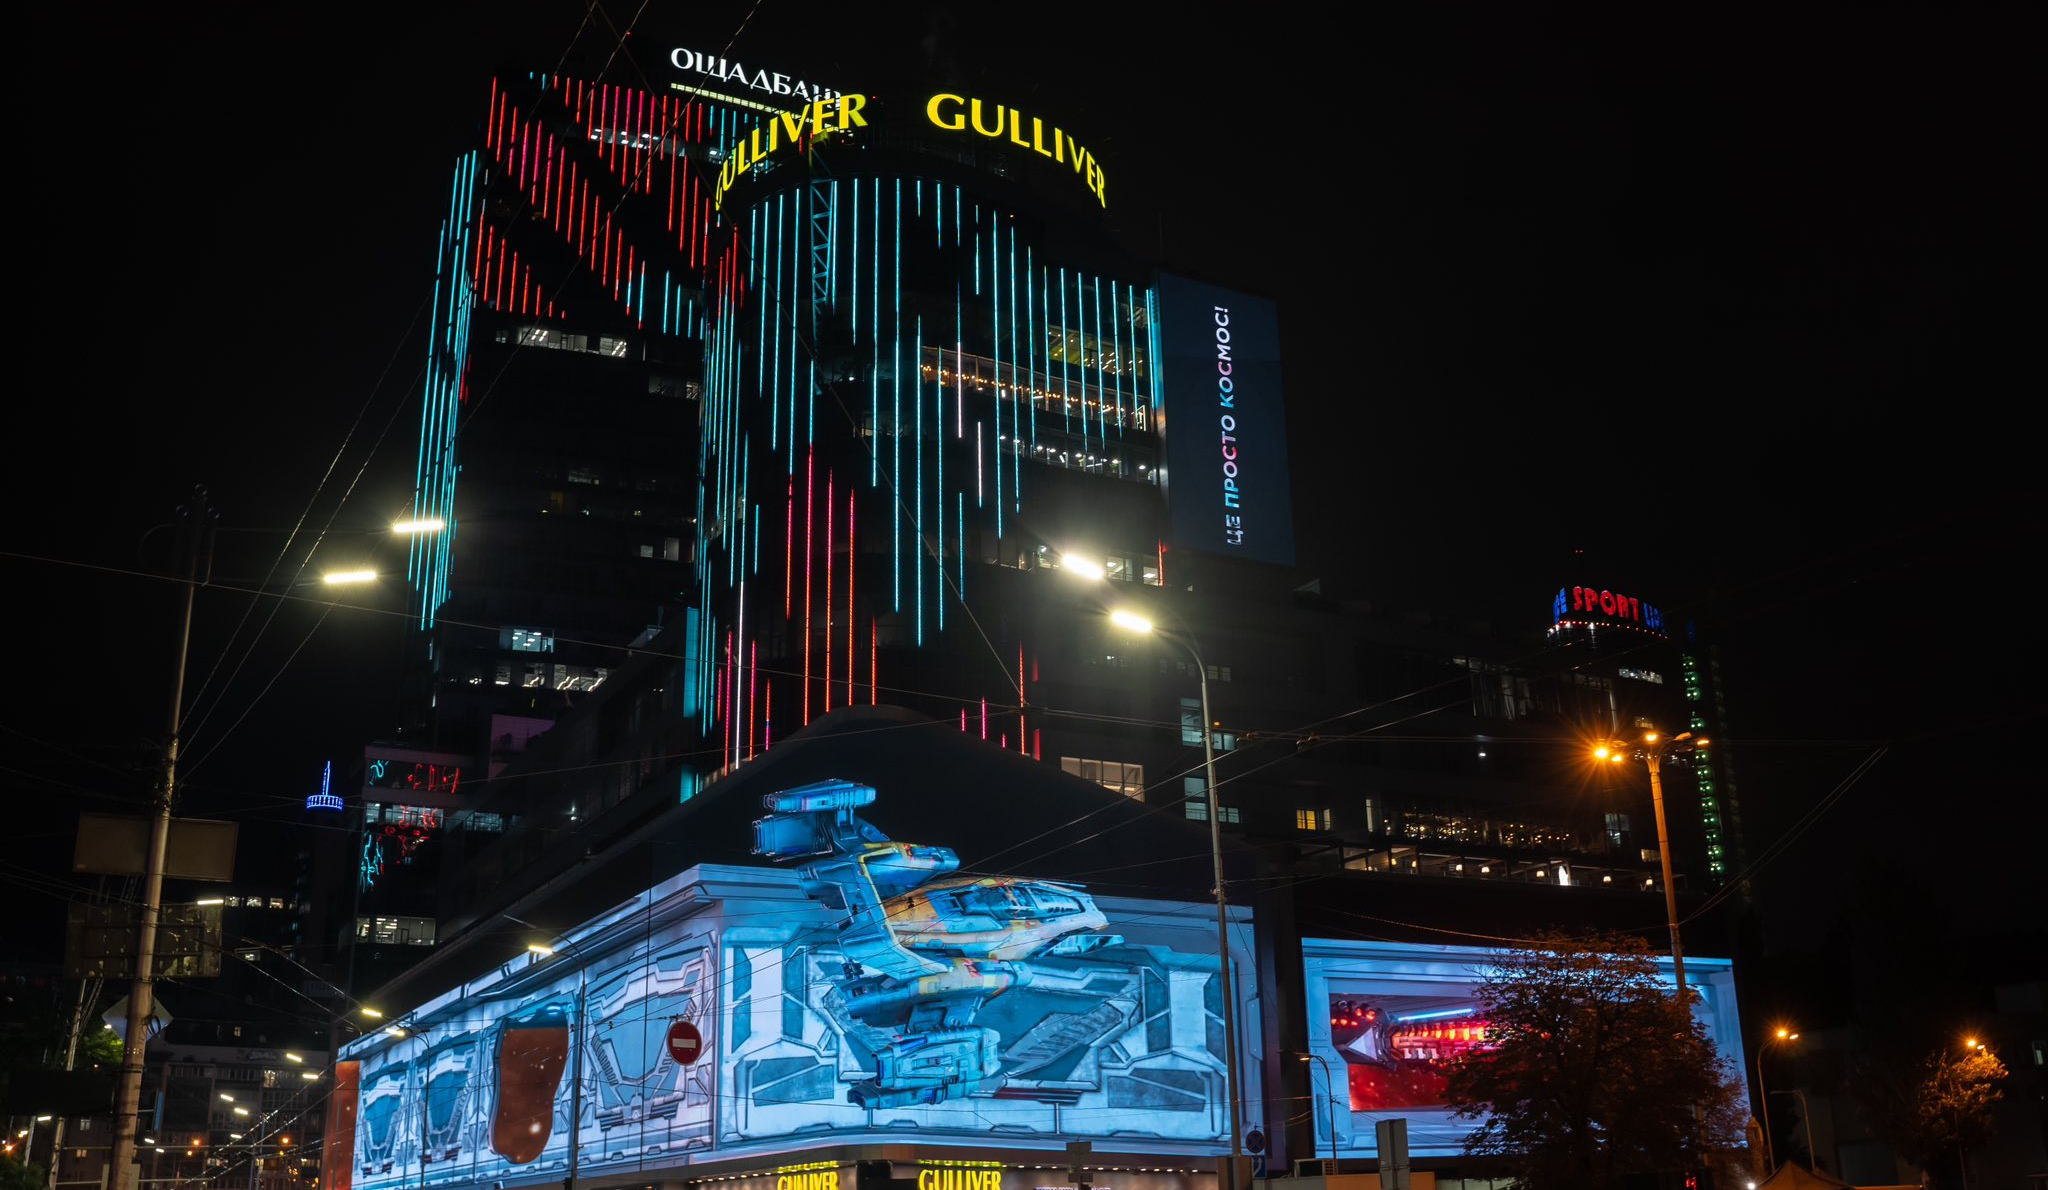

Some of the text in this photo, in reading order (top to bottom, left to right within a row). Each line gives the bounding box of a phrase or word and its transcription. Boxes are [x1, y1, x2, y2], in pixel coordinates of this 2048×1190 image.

[715, 93, 869, 212] GULLIVER
[926, 93, 1106, 209] GULLIVER
[1214, 305, 1244, 546] ЦЕ ПРОСТО КОСМОС!
[1572, 586, 1640, 622] SPORT
